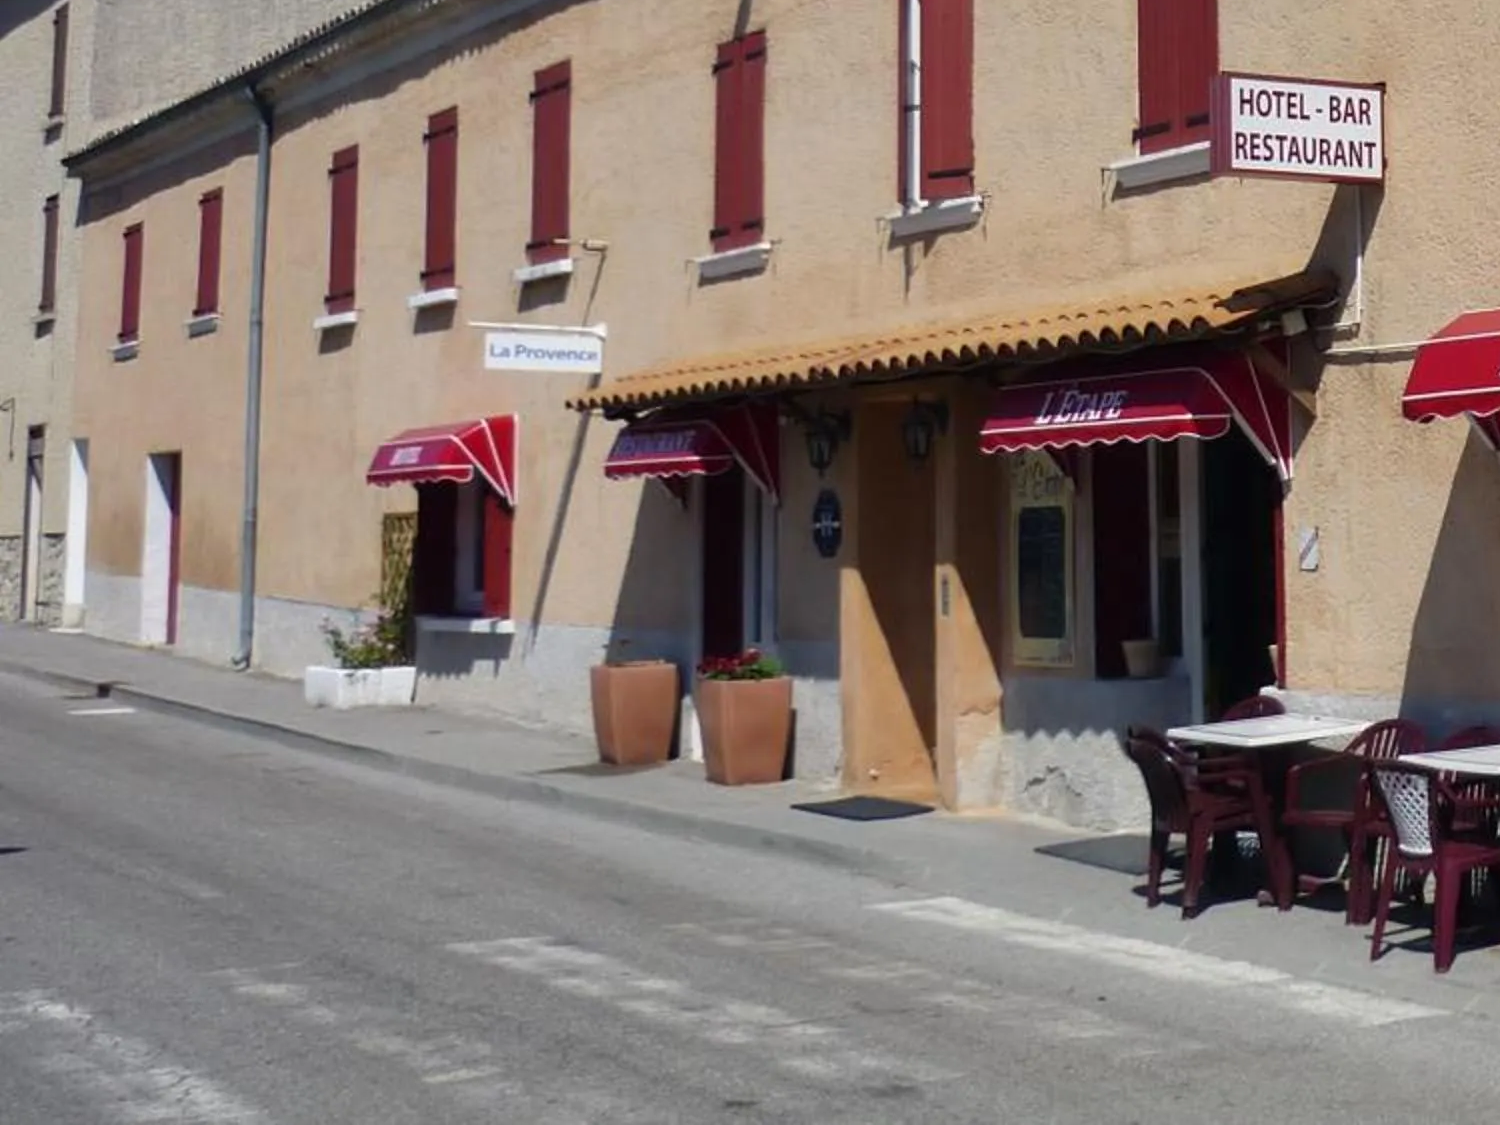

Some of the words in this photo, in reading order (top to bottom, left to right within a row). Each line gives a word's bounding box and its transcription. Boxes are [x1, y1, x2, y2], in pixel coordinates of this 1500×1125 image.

[1239, 88, 1310, 120] HOTEL
[1329, 96, 1372, 125] BAR
[1235, 132, 1376, 169] RESTAURANT
[490, 343, 511, 358] La
[514, 344, 598, 361] Provence
